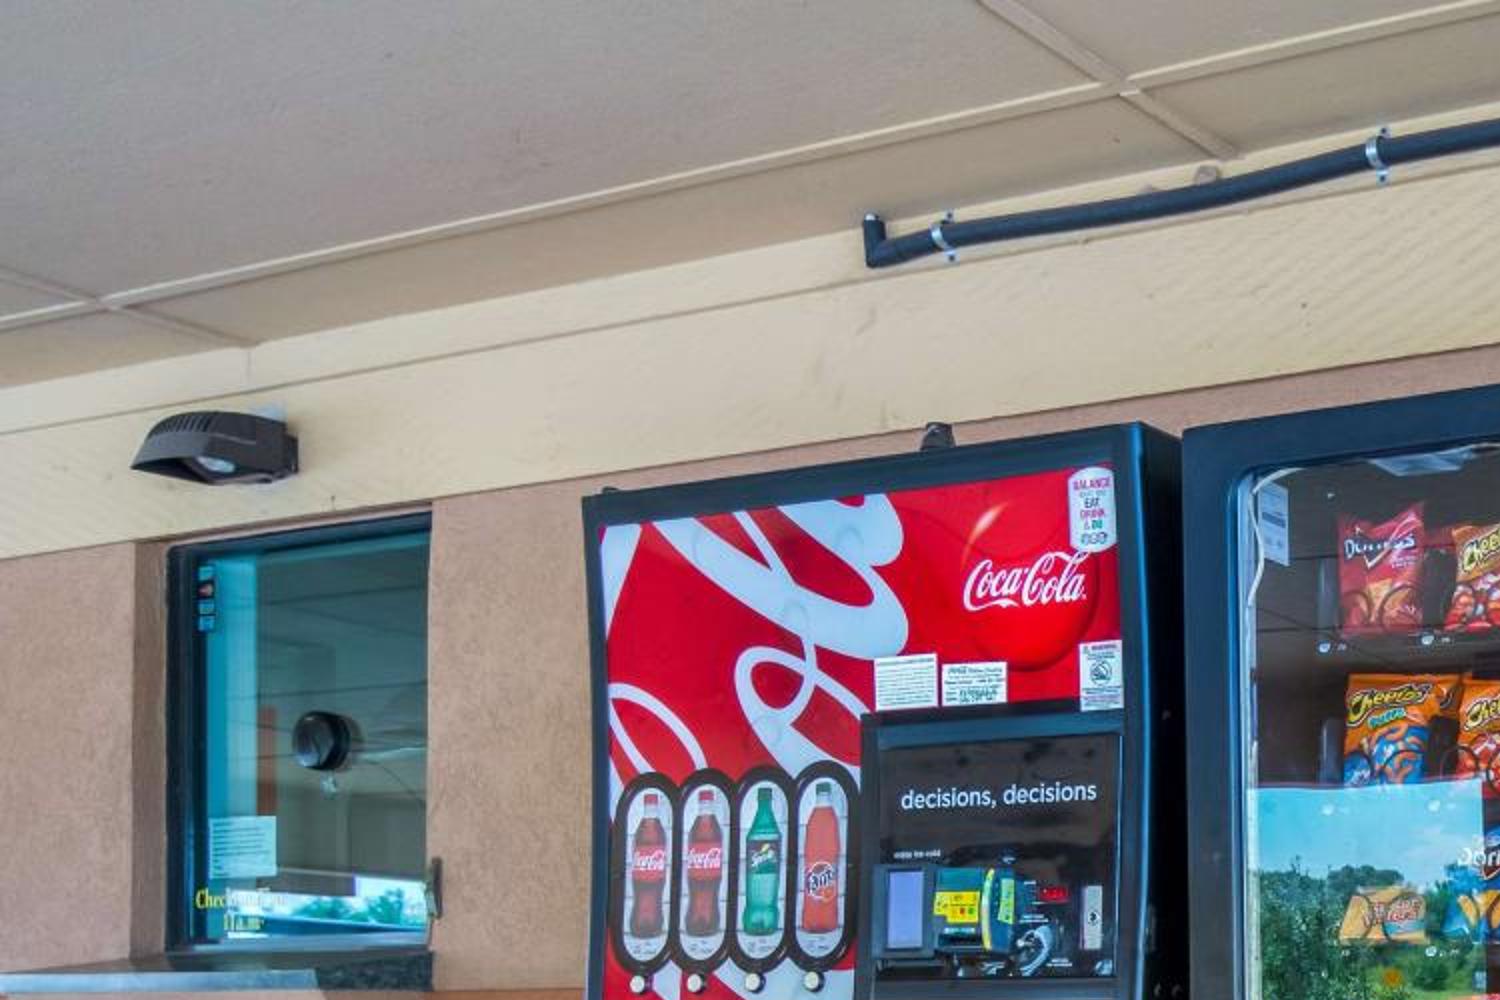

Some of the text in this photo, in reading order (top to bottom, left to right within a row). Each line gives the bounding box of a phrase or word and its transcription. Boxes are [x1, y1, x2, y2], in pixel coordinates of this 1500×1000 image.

[963, 550, 1087, 612] Coca-Cola
[1346, 683, 1434, 727] Cheetos
[901, 782, 1097, 811] decisions, decisions
